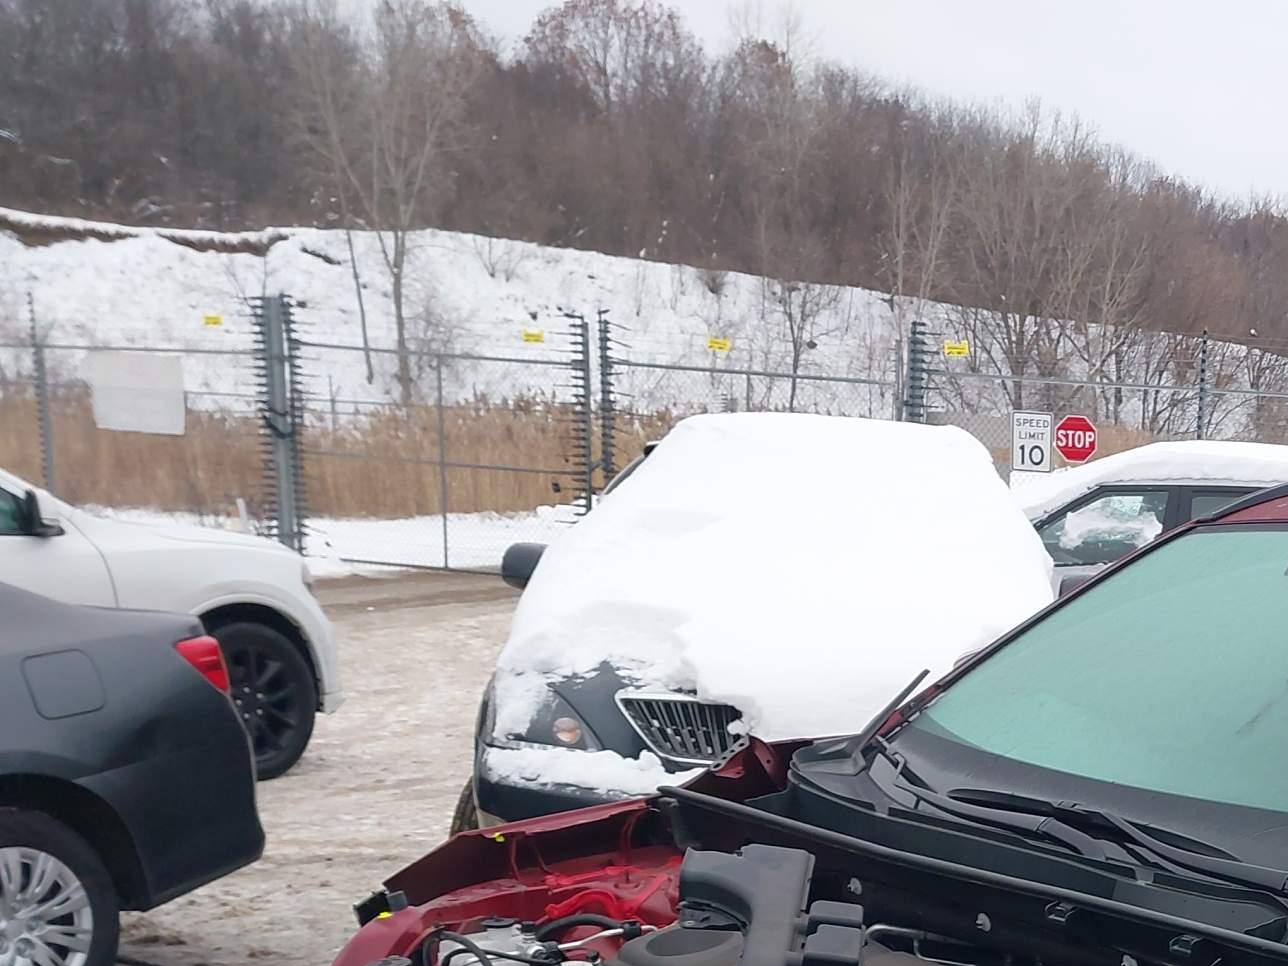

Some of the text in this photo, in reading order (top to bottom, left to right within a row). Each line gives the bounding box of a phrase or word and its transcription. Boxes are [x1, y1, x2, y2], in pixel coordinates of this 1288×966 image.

[1015, 418, 1049, 428] SPEED
[1019, 431, 1045, 441] LIMIT
[1057, 429, 1095, 448] STOP
[1019, 444, 1044, 466] 10
